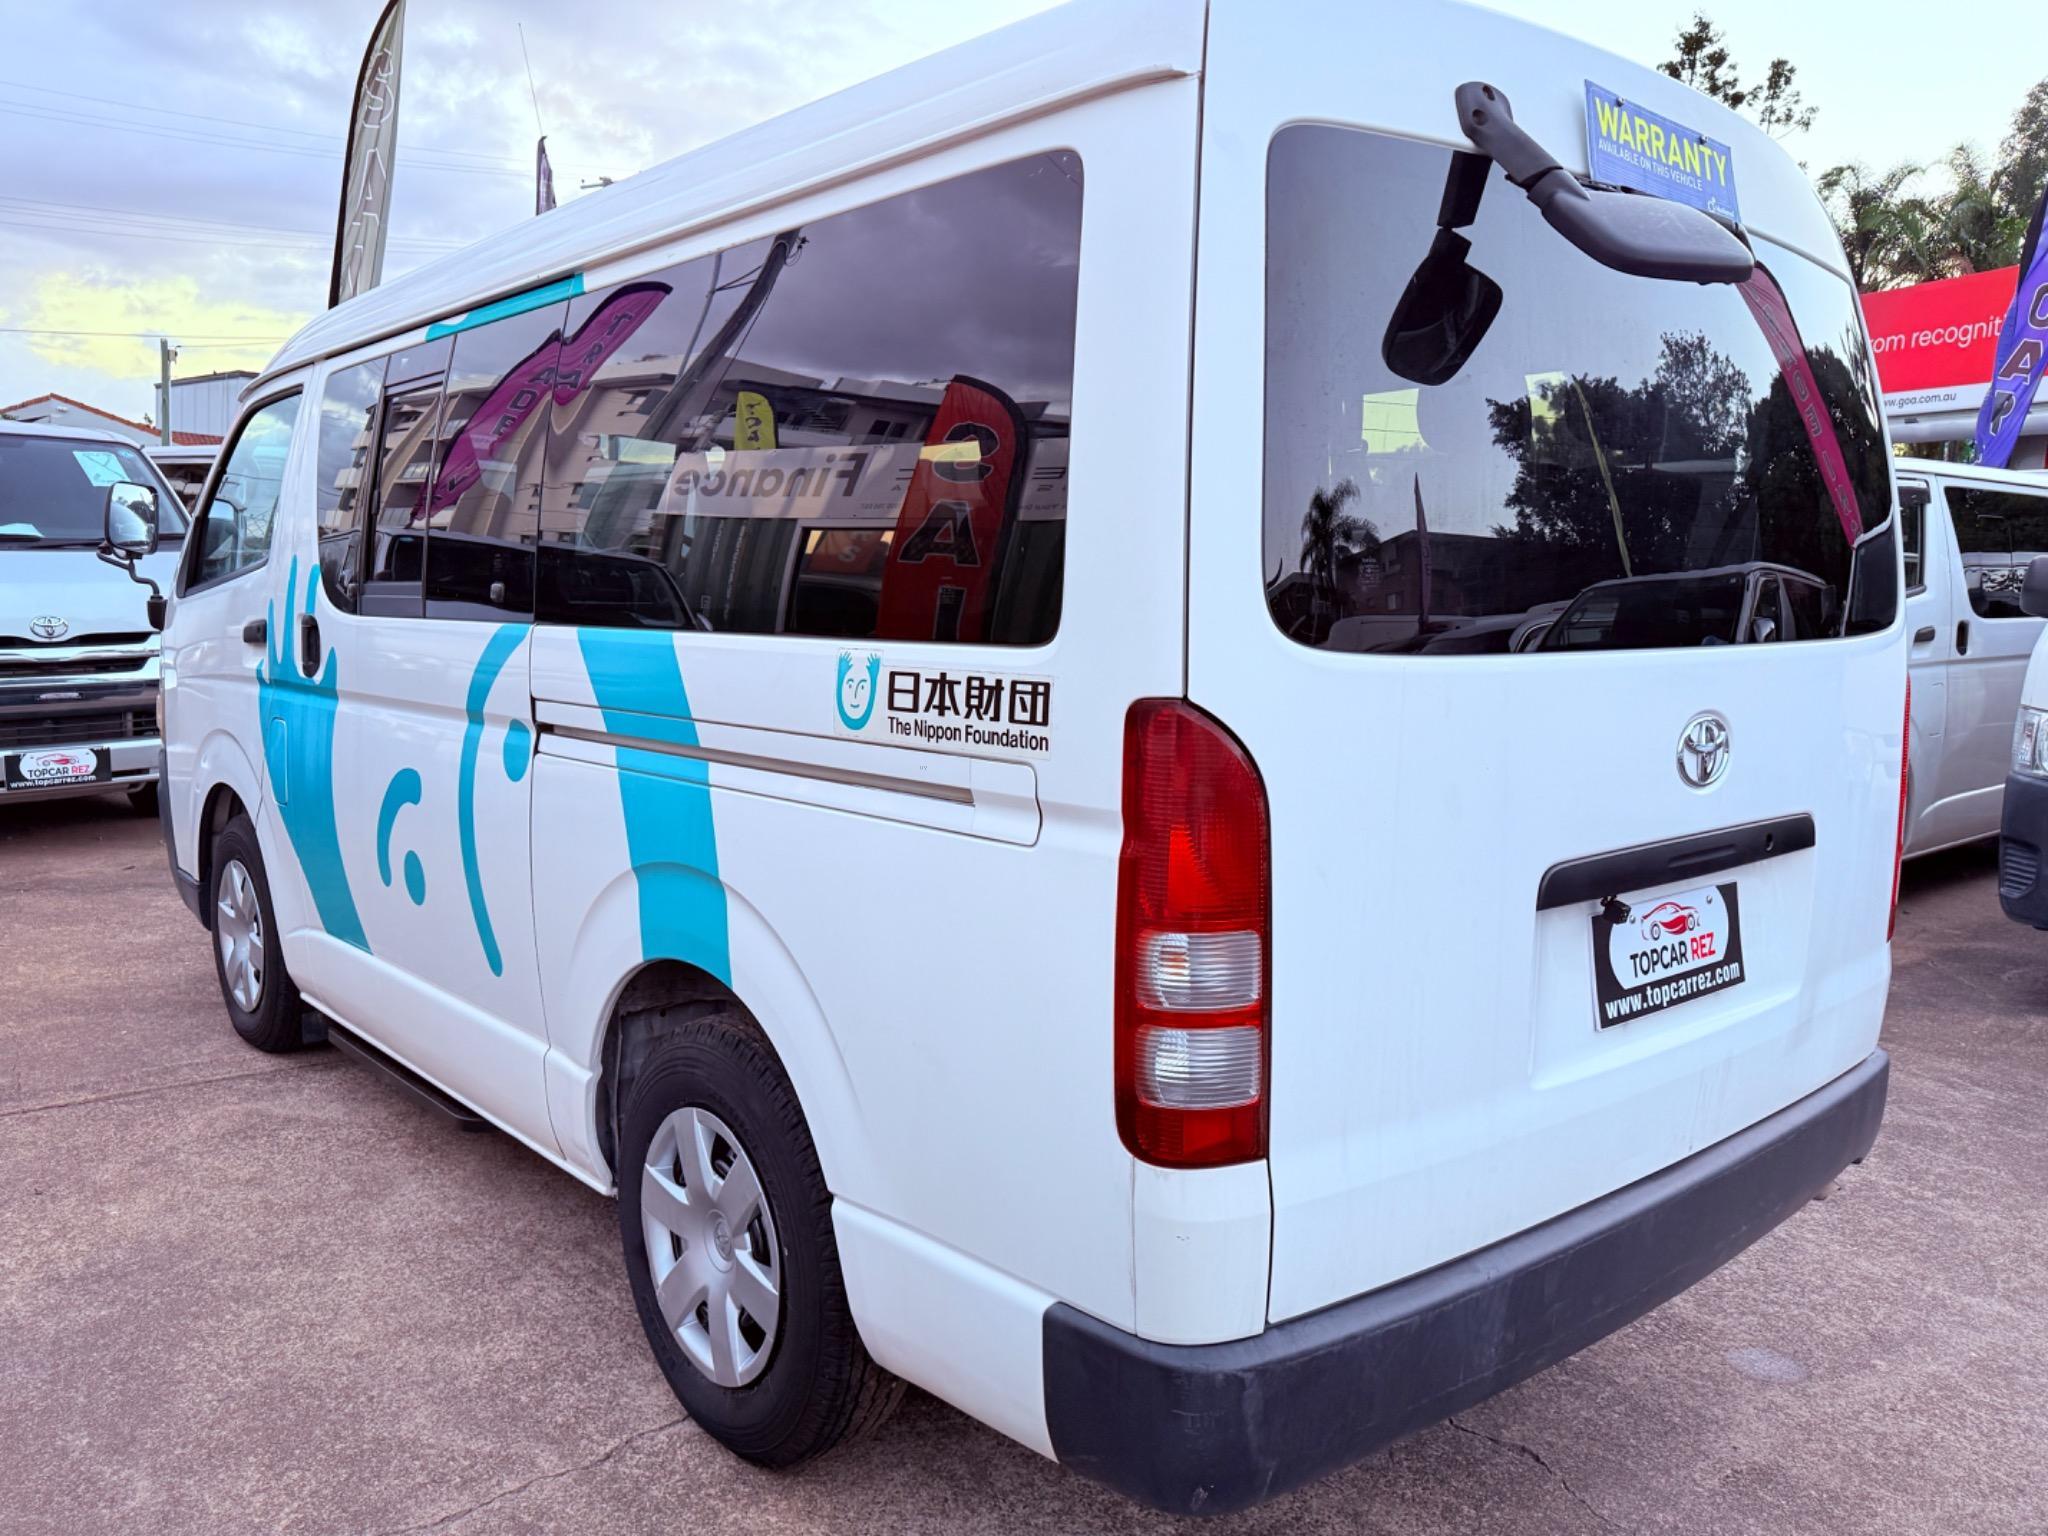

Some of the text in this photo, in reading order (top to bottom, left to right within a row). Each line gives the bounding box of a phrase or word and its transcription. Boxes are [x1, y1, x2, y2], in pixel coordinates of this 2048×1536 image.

[1594, 96, 1727, 188] WARRANTY
[1598, 138, 1704, 192] AVAILABLE ON THIS VEHICLE
[1910, 314, 2006, 348] recognit
[887, 670, 1051, 727] 日本財団
[887, 716, 1050, 752] The Nippon Foundation
[27, 764, 90, 778] TOPCAR REZ
[1629, 931, 1717, 979] TOPCAR REZ
[1605, 961, 1741, 1020] www.topcarrez.com
